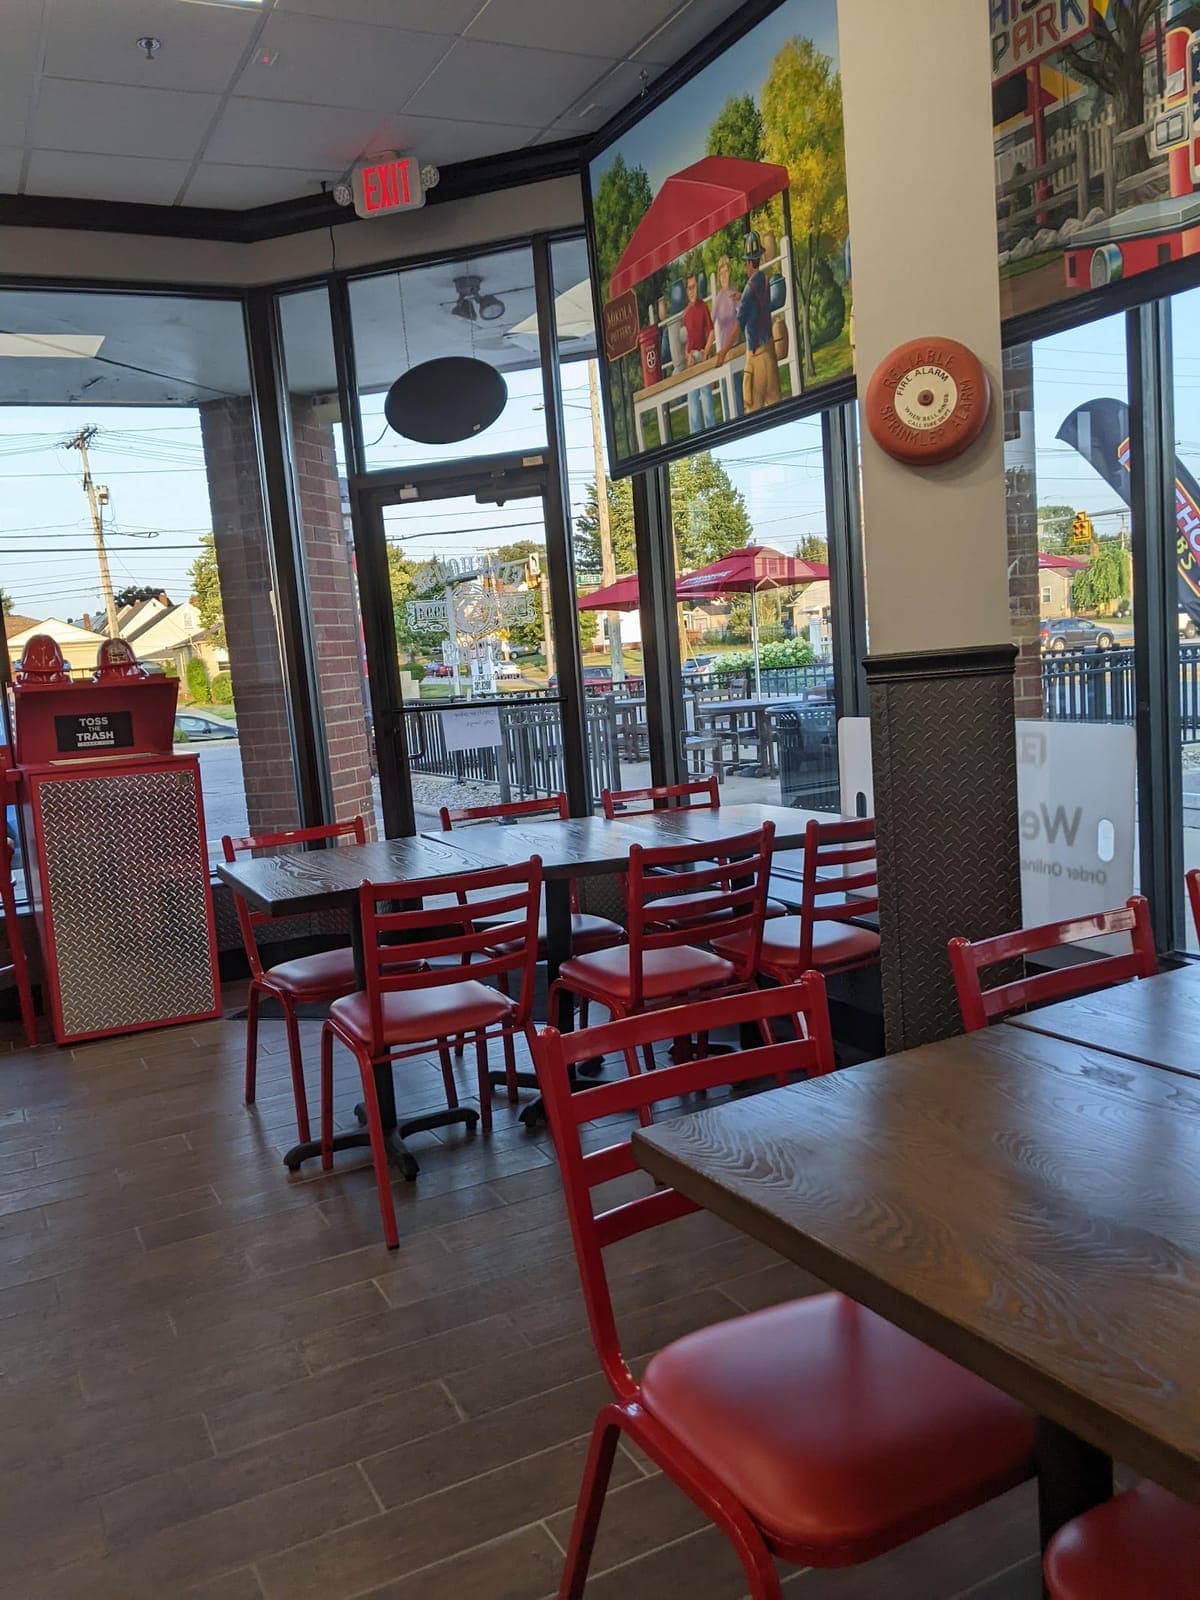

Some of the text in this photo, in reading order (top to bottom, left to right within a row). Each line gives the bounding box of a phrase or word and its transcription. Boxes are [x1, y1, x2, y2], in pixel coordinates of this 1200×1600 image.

[992, 0, 1086, 73] PARK
[361, 159, 411, 212] EXIT
[897, 367, 949, 396] FIRE ALARM
[880, 379, 975, 447] SPRINKLER ALARM
[904, 406, 921, 421] WHEN
[922, 413, 939, 422] BELL
[907, 419, 922, 428] CALL
[79, 716, 109, 726] TOSS
[75, 731, 115, 742] TRASH
